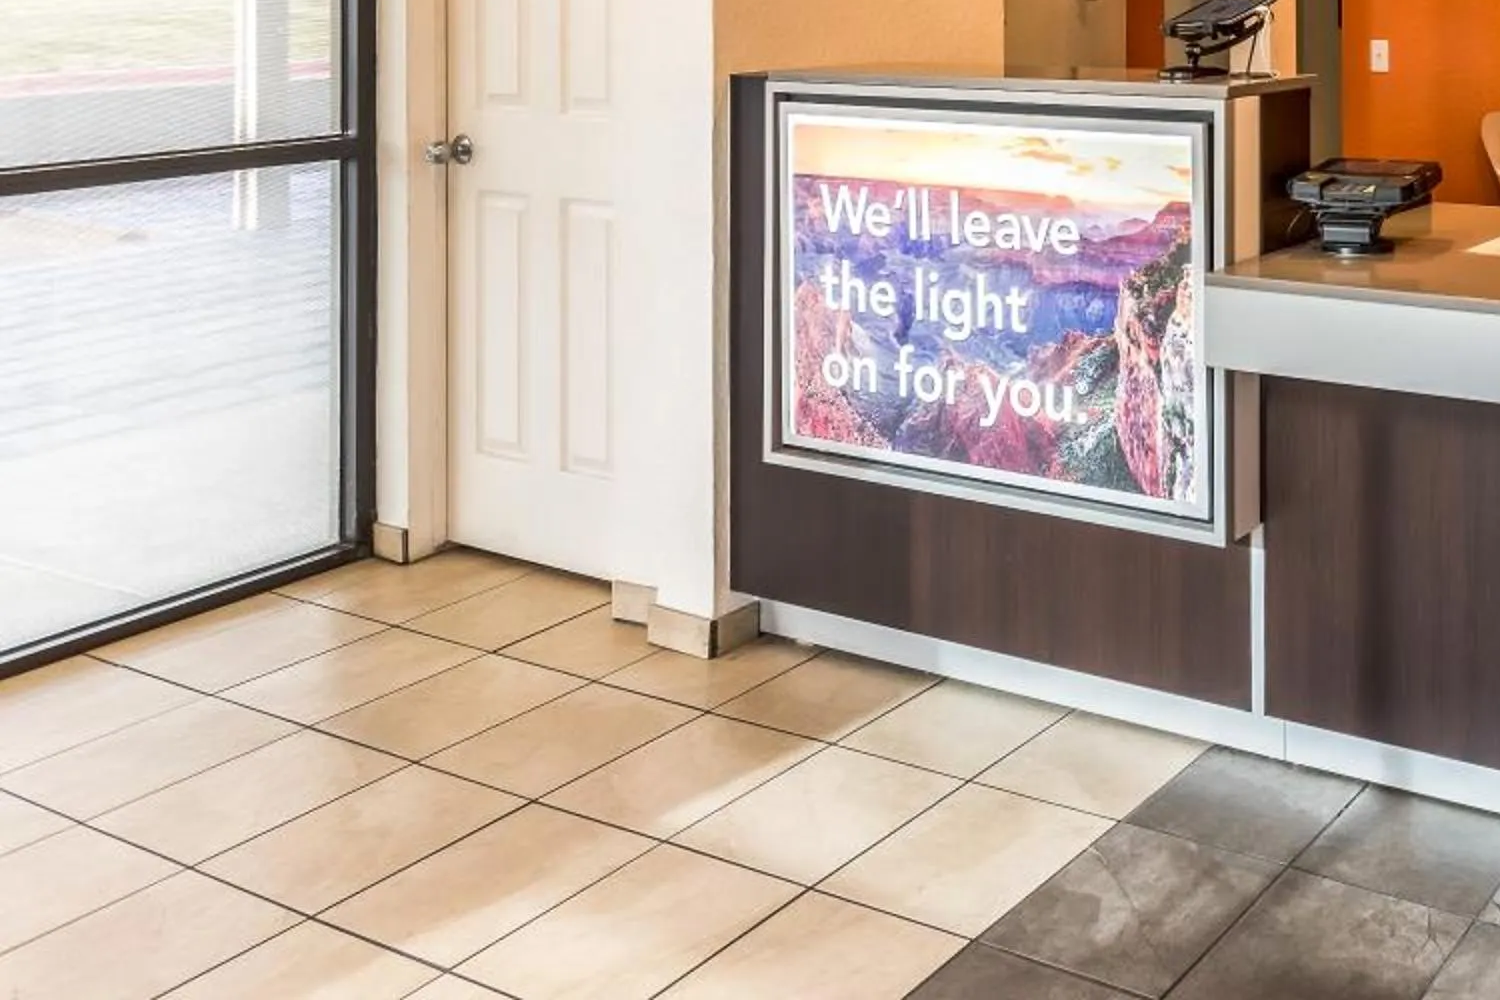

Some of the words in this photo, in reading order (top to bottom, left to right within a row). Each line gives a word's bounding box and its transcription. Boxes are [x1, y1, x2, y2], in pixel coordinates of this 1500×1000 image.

[819, 183, 931, 241] We'll
[949, 188, 1081, 255] leave
[820, 259, 897, 317] the
[914, 266, 1028, 341] light
[821, 352, 878, 393] on
[893, 343, 966, 405] for
